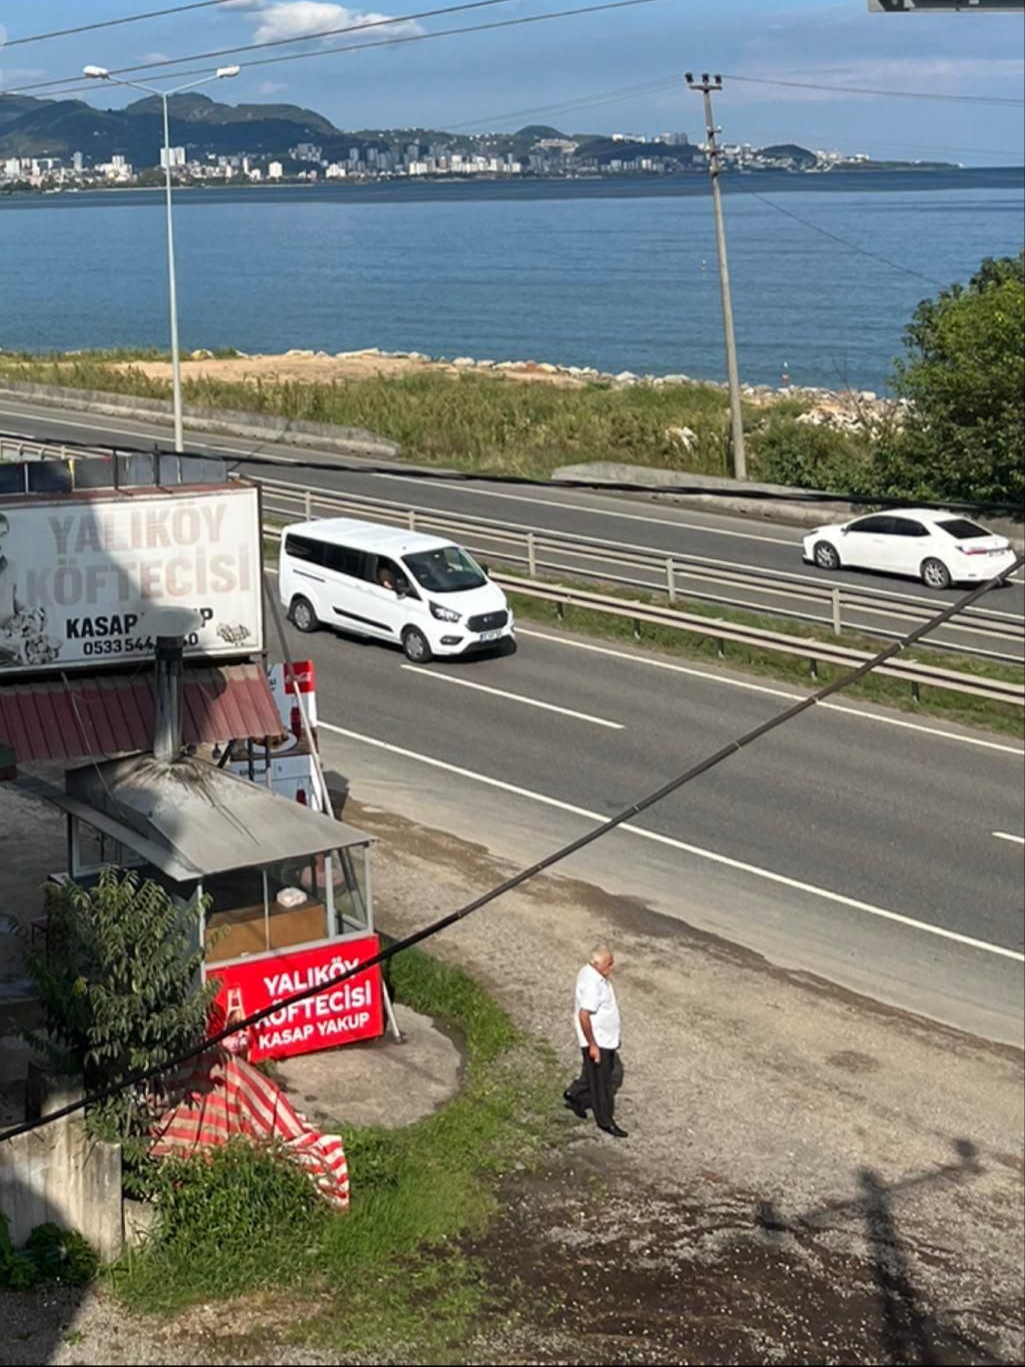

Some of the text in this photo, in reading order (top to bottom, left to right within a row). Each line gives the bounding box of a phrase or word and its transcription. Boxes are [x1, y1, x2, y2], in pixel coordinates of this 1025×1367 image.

[48, 501, 228, 556] YALIKÖY
[25, 543, 250, 608] KÖFTECİSİ
[66, 614, 138, 639] KASAP
[83, 639, 122, 655] 0533
[263, 955, 359, 998] YALIKÖY
[258, 1012, 370, 1050] KASAP YAKUP
